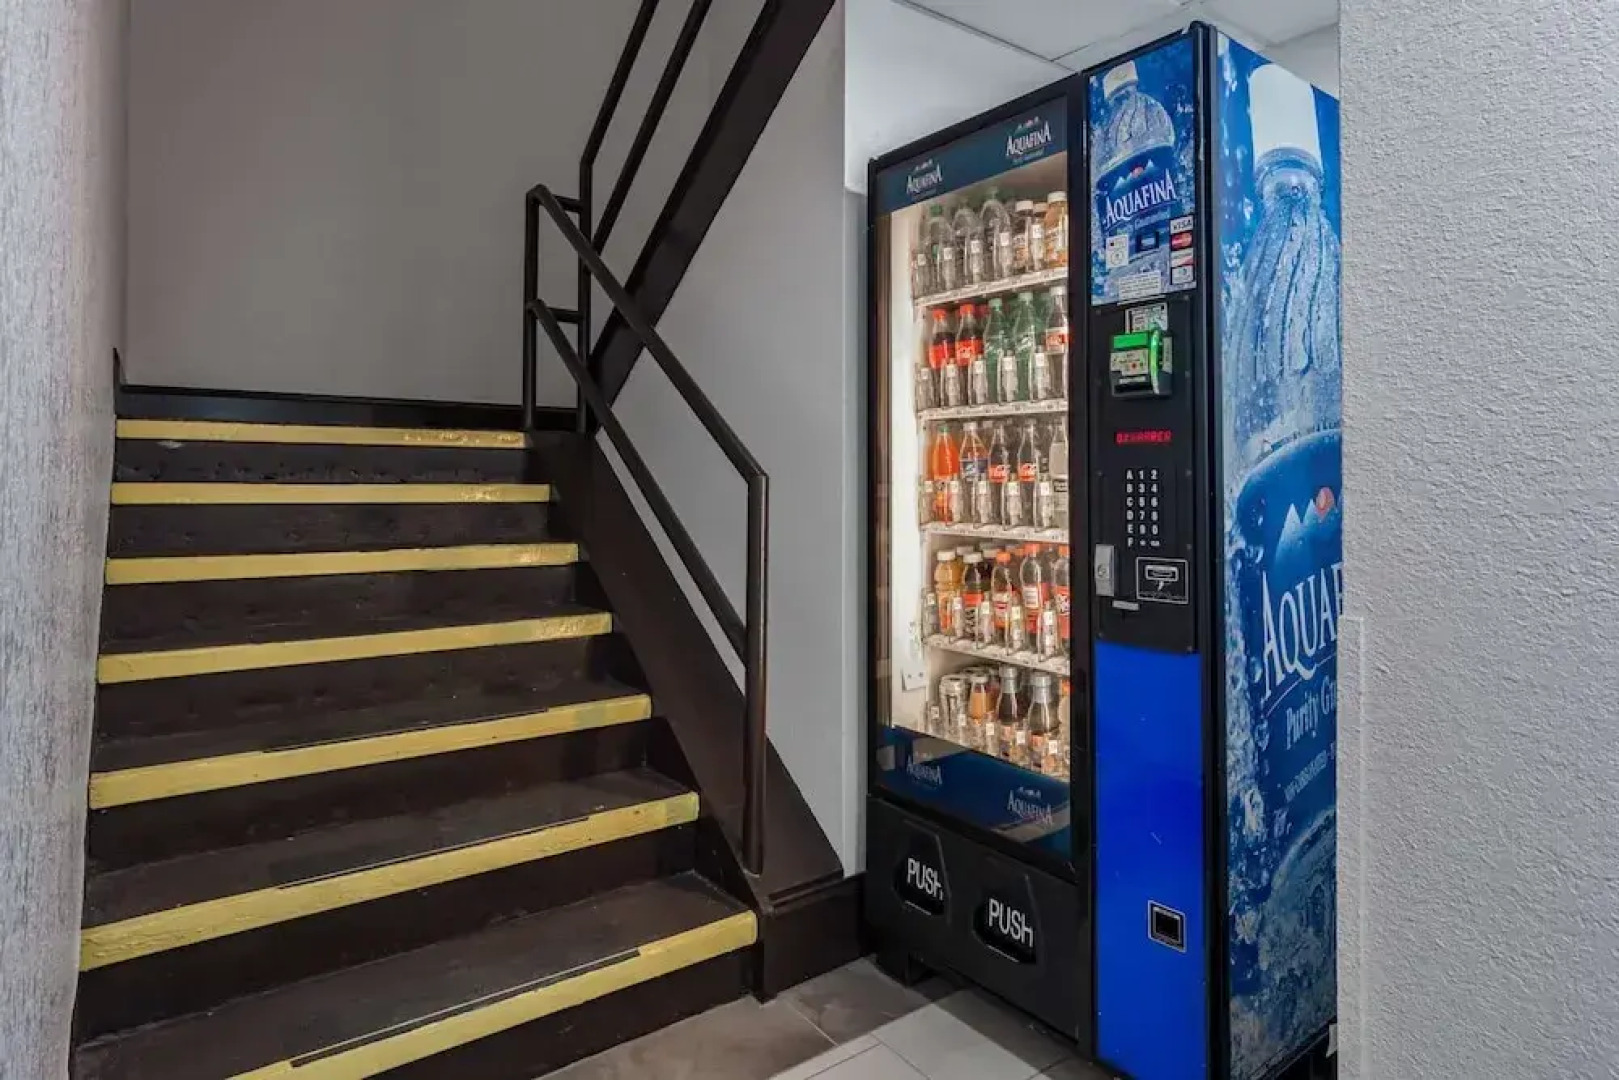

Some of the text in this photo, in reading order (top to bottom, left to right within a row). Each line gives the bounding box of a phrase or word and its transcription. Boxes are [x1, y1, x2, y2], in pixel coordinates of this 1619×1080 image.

[1006, 121, 1051, 156] AQUAFINA
[1103, 168, 1177, 228] AQUAFINA
[1126, 469, 1157, 480] A 1 2
[1286, 690, 1319, 750] Purity
[907, 857, 944, 901] PUSH
[988, 898, 1034, 948] PUSH
